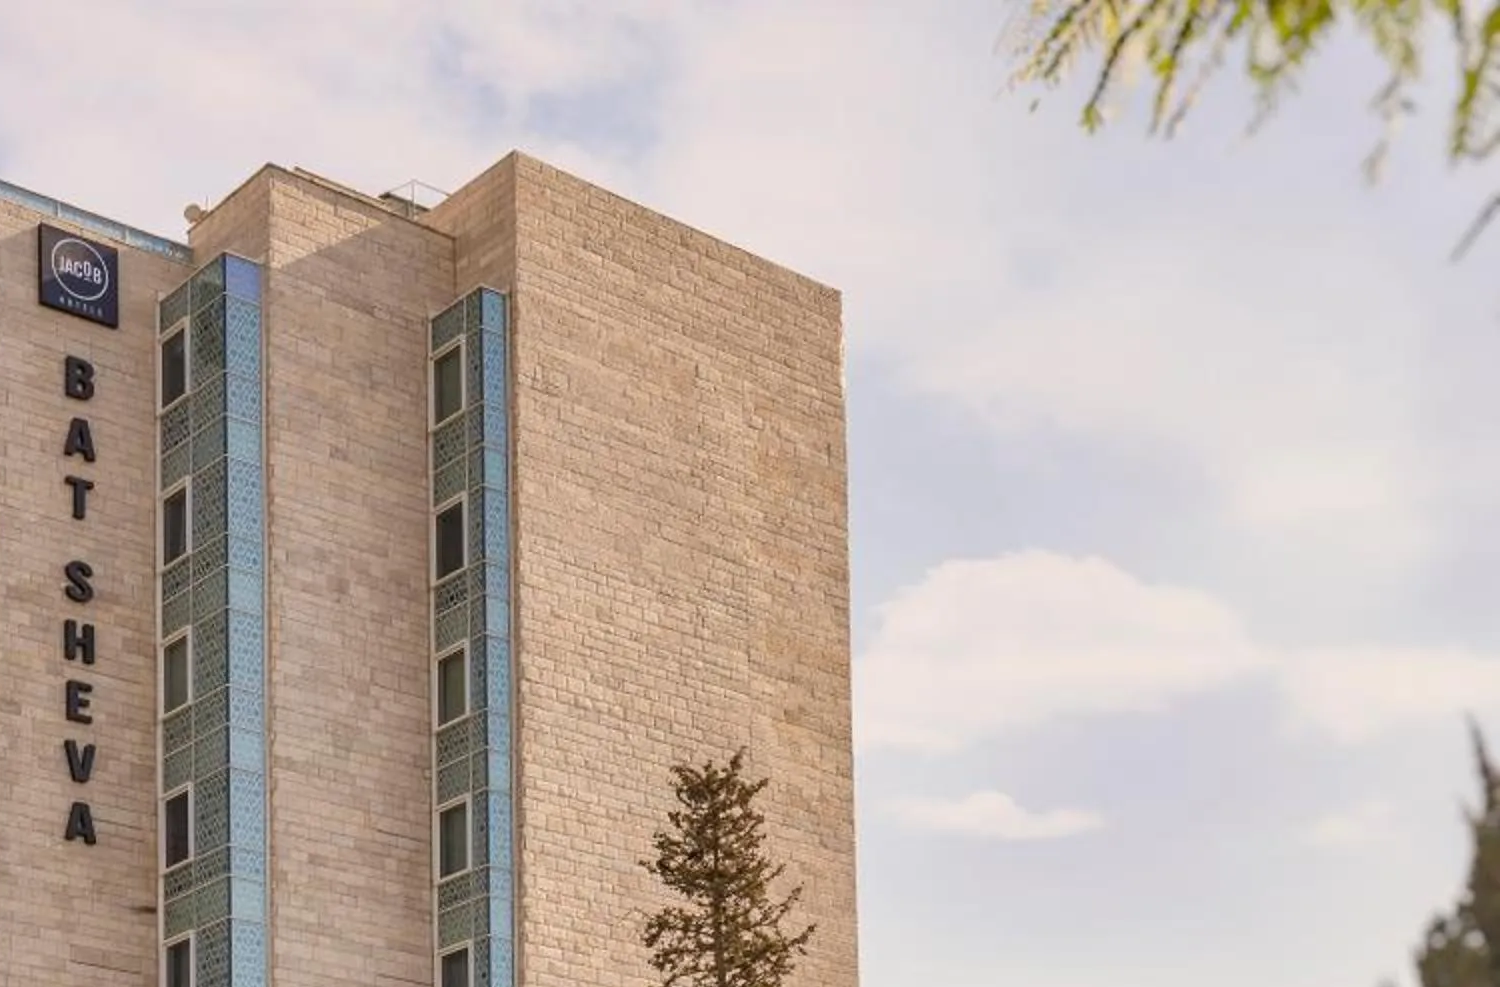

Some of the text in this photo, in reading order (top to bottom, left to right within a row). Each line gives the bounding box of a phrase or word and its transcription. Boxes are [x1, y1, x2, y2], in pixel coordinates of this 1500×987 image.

[59, 256, 102, 285] JACOB
[63, 356, 96, 845] BAT SHEVA
